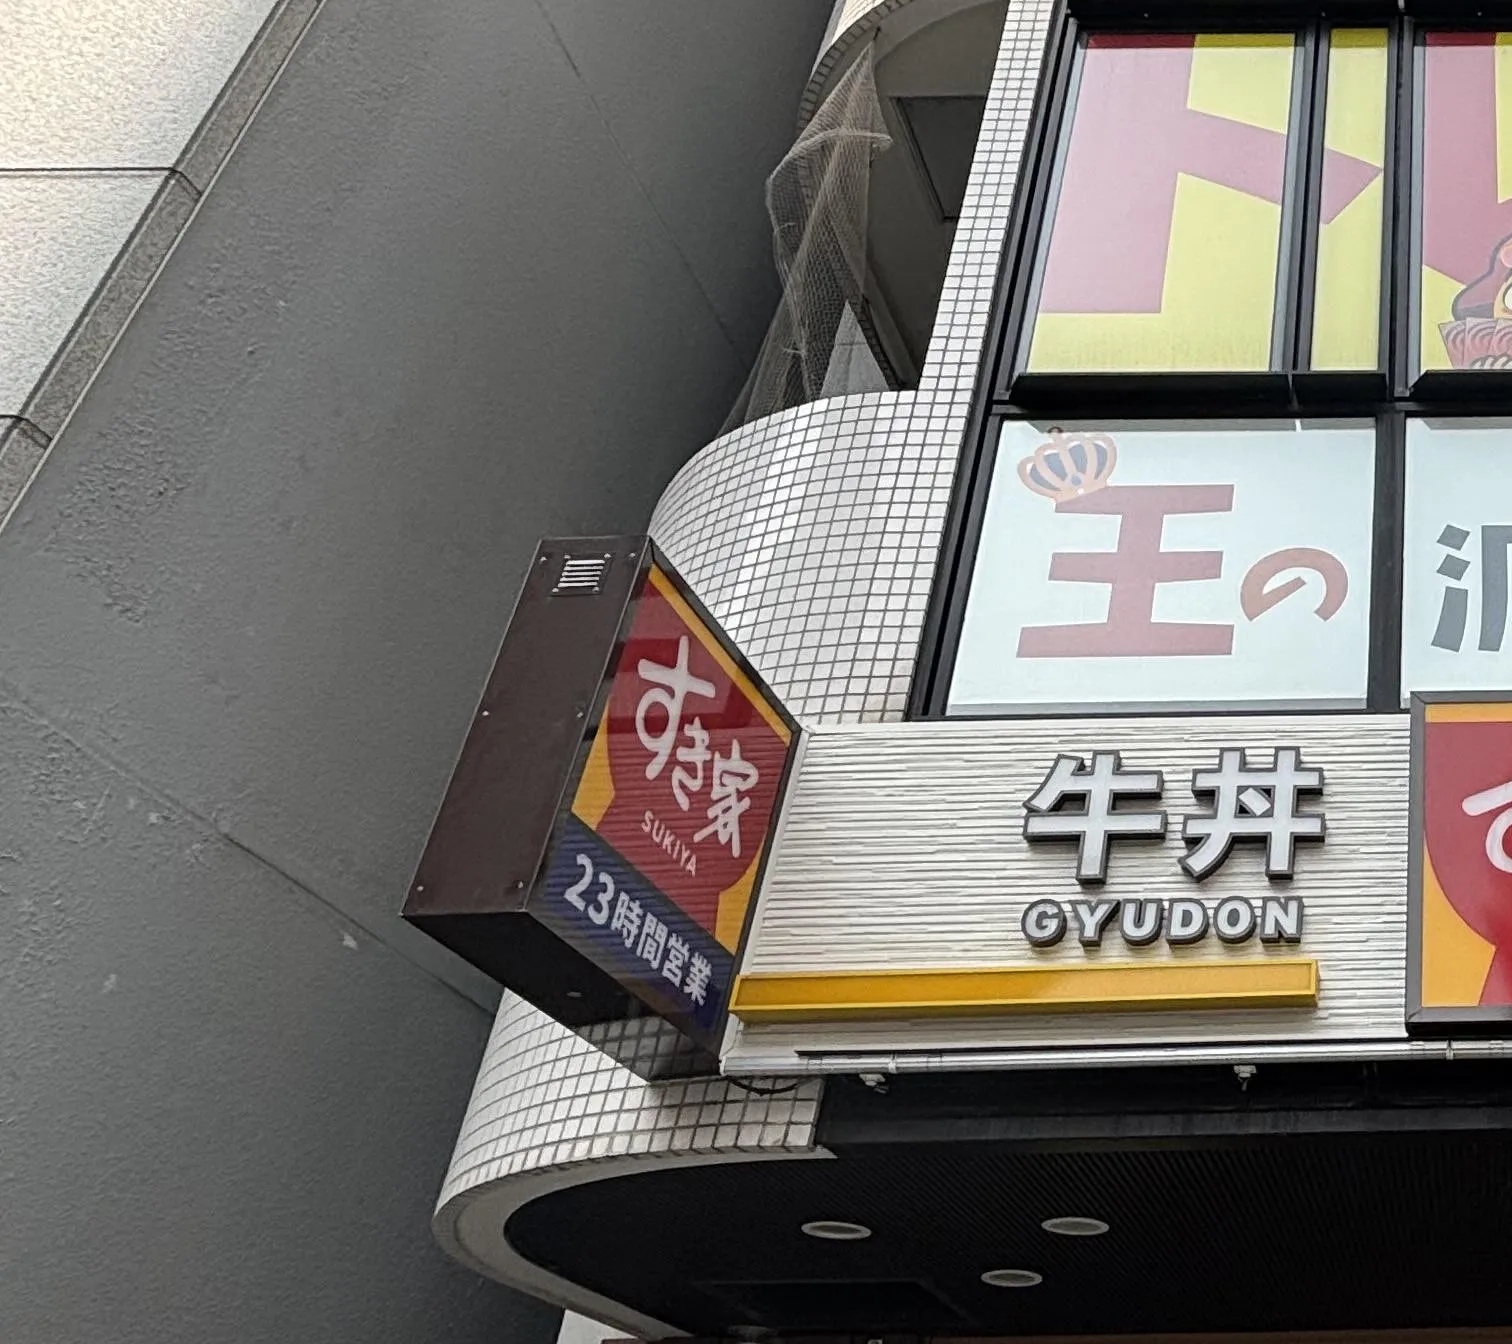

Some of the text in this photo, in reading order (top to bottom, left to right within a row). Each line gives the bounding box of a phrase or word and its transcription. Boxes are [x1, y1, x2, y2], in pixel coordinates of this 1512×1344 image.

[637, 635, 760, 858] すき家
[639, 809, 699, 878] SUKIYA
[1022, 748, 1326, 885] 牛丼
[562, 853, 714, 1007] 23時間営業
[1020, 895, 1304, 949] GYUDON
